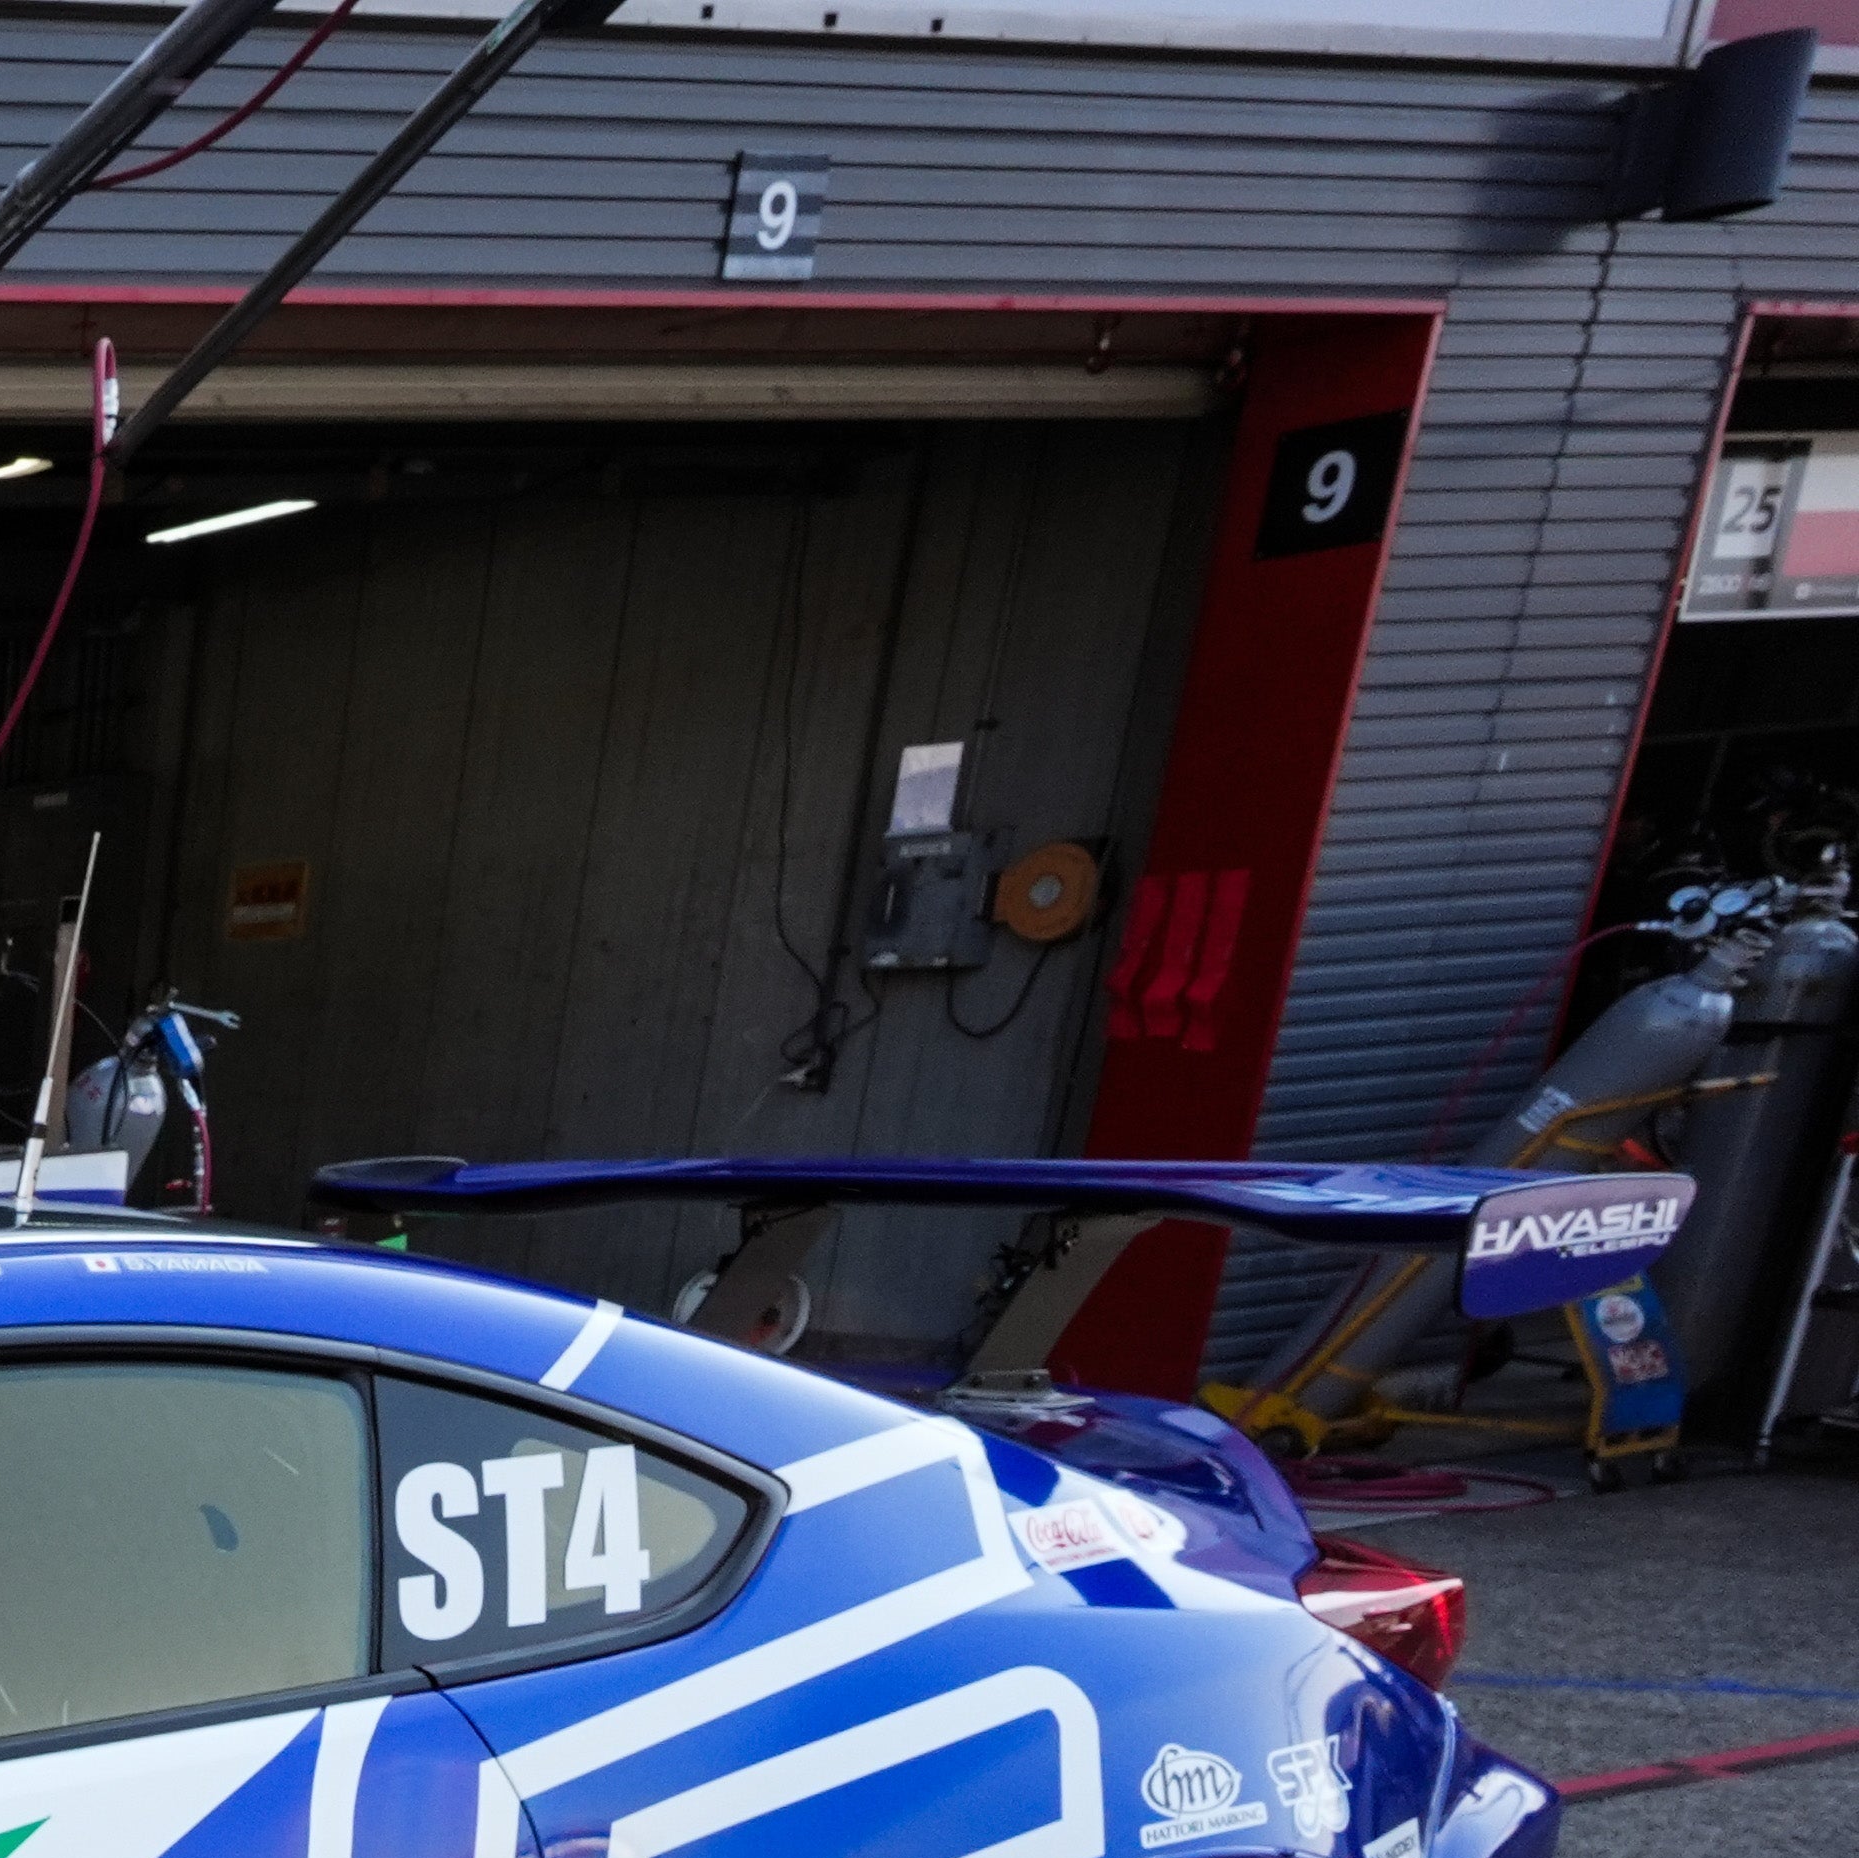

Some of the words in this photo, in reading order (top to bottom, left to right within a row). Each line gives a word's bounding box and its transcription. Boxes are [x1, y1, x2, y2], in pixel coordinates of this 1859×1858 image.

[757, 182, 798, 249] 9
[1304, 450, 1357, 524] 9
[1723, 486, 1781, 534] 25
[1467, 1198, 1680, 1259] HAYASHI
[393, 1443, 650, 1641] ST4
